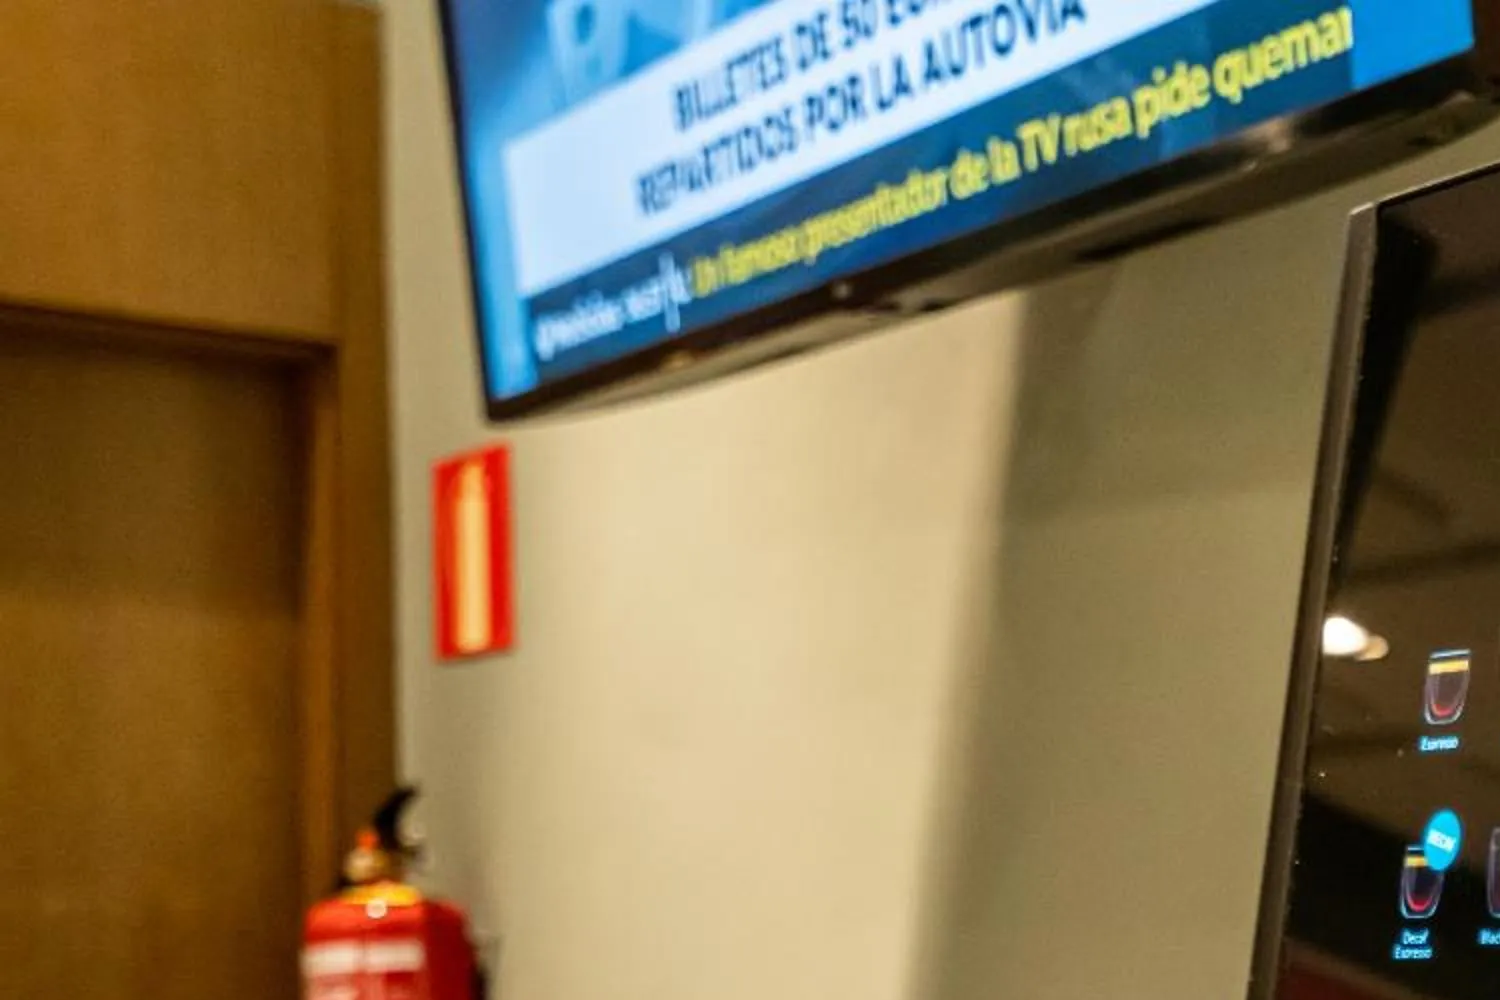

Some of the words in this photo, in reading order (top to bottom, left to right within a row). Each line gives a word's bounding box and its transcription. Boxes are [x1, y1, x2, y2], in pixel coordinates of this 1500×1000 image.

[674, 33, 791, 132] BILLETES
[792, 12, 833, 70] DE
[838, 0, 880, 48] 50
[949, 147, 989, 200] de
[988, 136, 1022, 186] la
[1017, 112, 1064, 170] TV
[1063, 96, 1132, 156] rusa
[1132, 58, 1212, 139] pide
[636, 104, 799, 215] REPARTIDOS
[804, 76, 867, 142] POR
[871, 56, 915, 113] LA
[1403, 928, 1430, 944] Decaf
